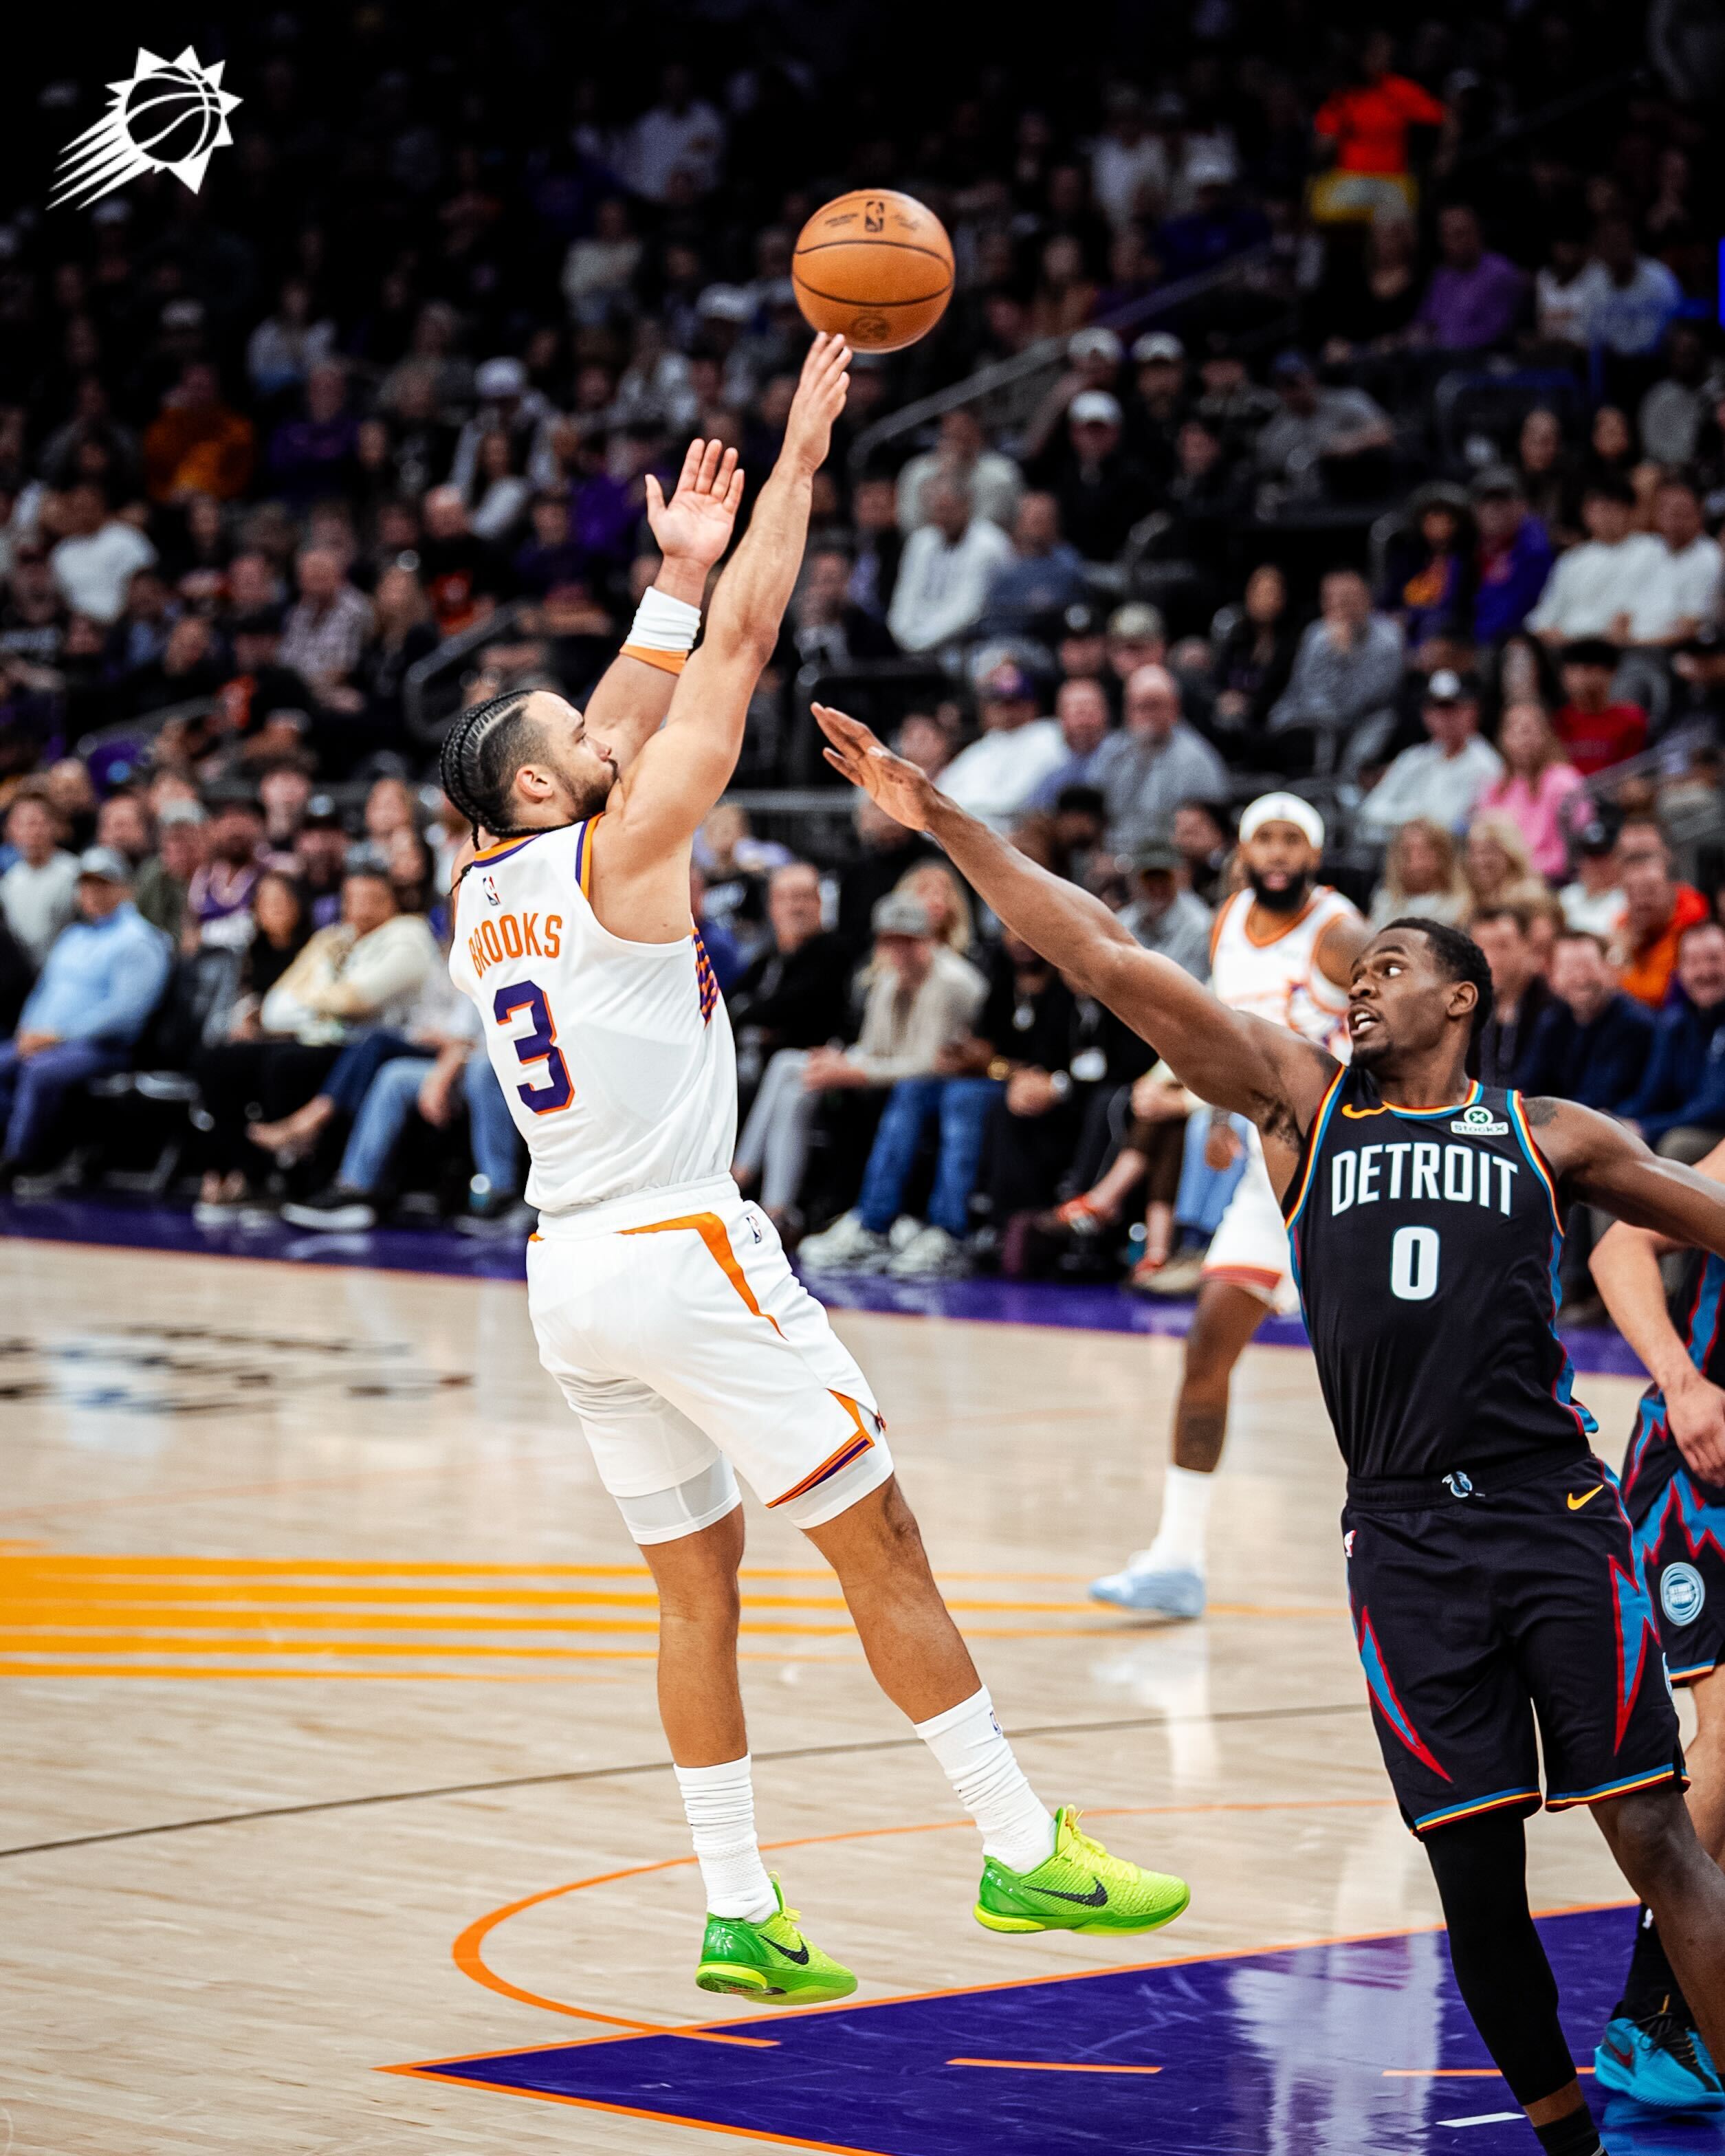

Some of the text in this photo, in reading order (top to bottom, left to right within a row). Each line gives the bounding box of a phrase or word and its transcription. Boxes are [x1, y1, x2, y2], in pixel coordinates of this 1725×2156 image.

[468, 912, 562, 979] BROOKS
[494, 980, 575, 1115] 3
[1332, 1143, 1518, 1216] DETROIT
[1390, 1226, 1440, 1300] 0
